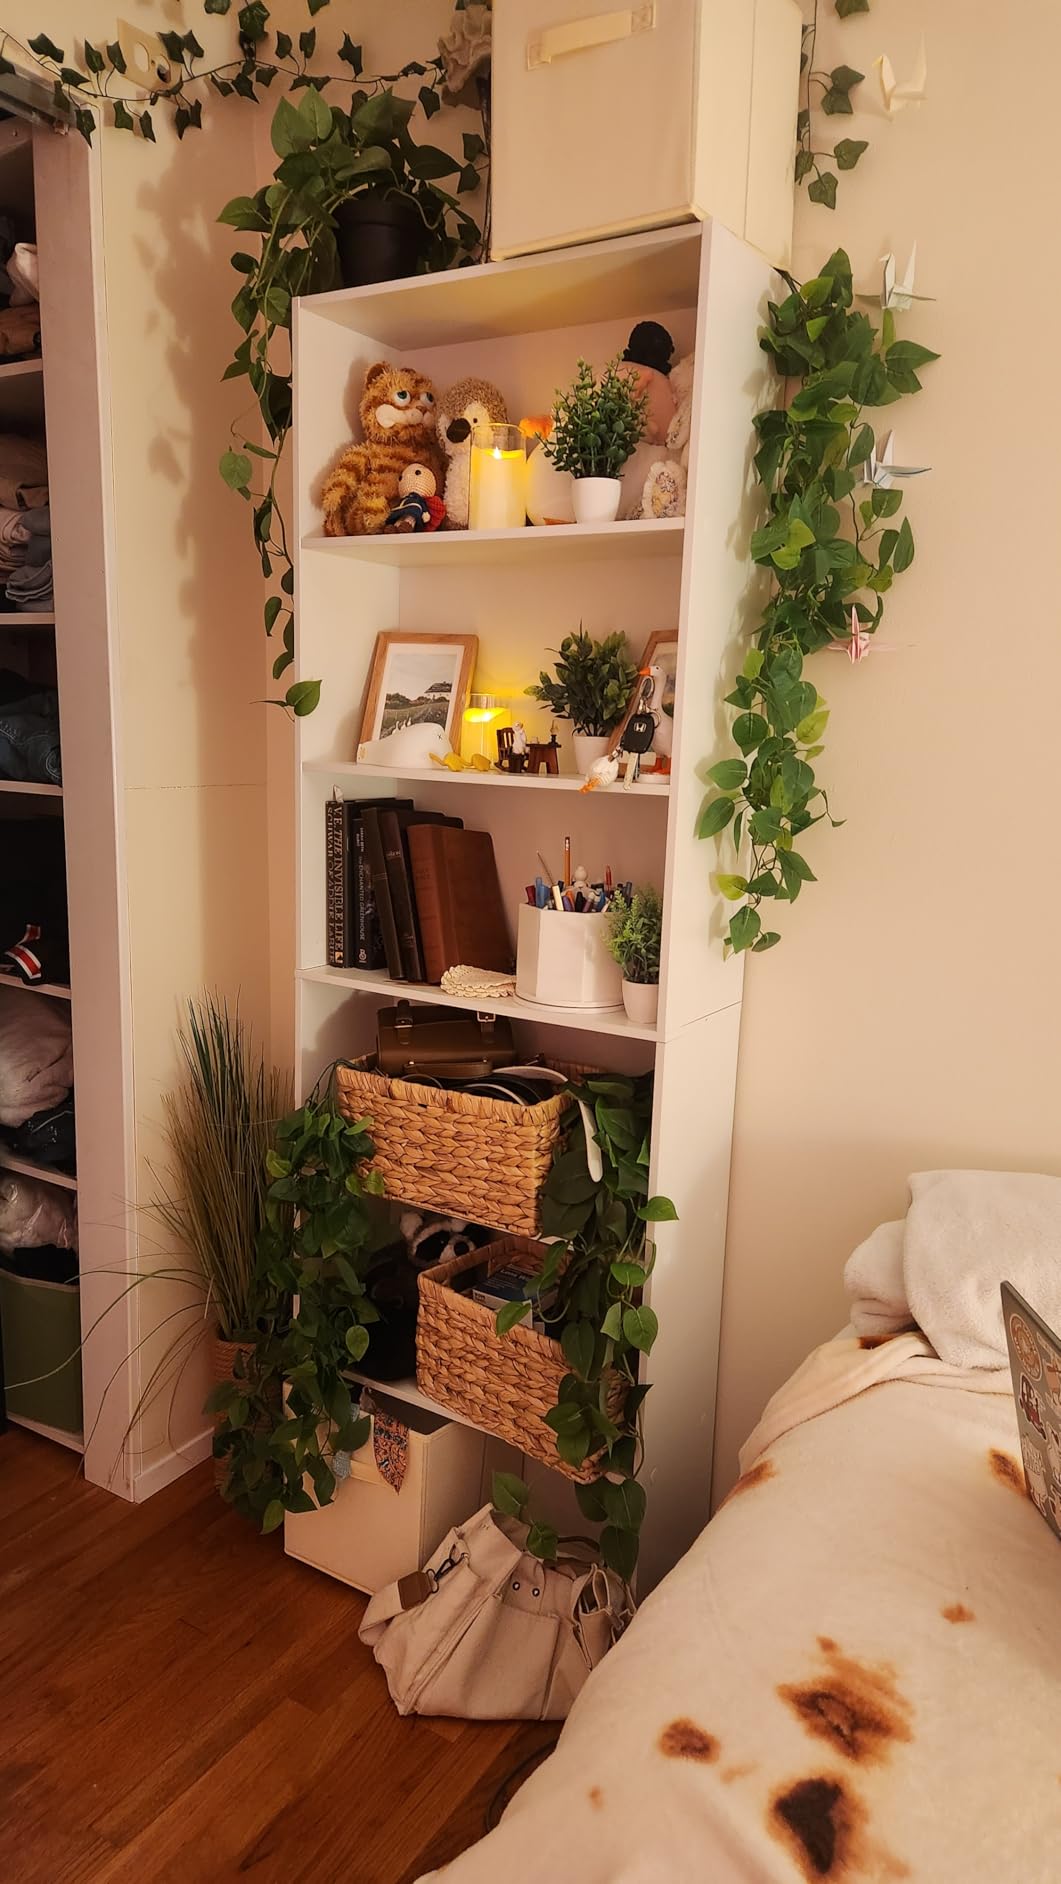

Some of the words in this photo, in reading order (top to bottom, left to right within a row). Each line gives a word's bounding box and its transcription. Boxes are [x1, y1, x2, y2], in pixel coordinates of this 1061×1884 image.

[334, 807, 343, 815] V.
[334, 818, 343, 828] E.
[334, 830, 343, 855] THE
[328, 860, 334, 878] OF
[334, 857, 343, 920] INVISIBLE
[335, 923, 343, 951] LIFE
